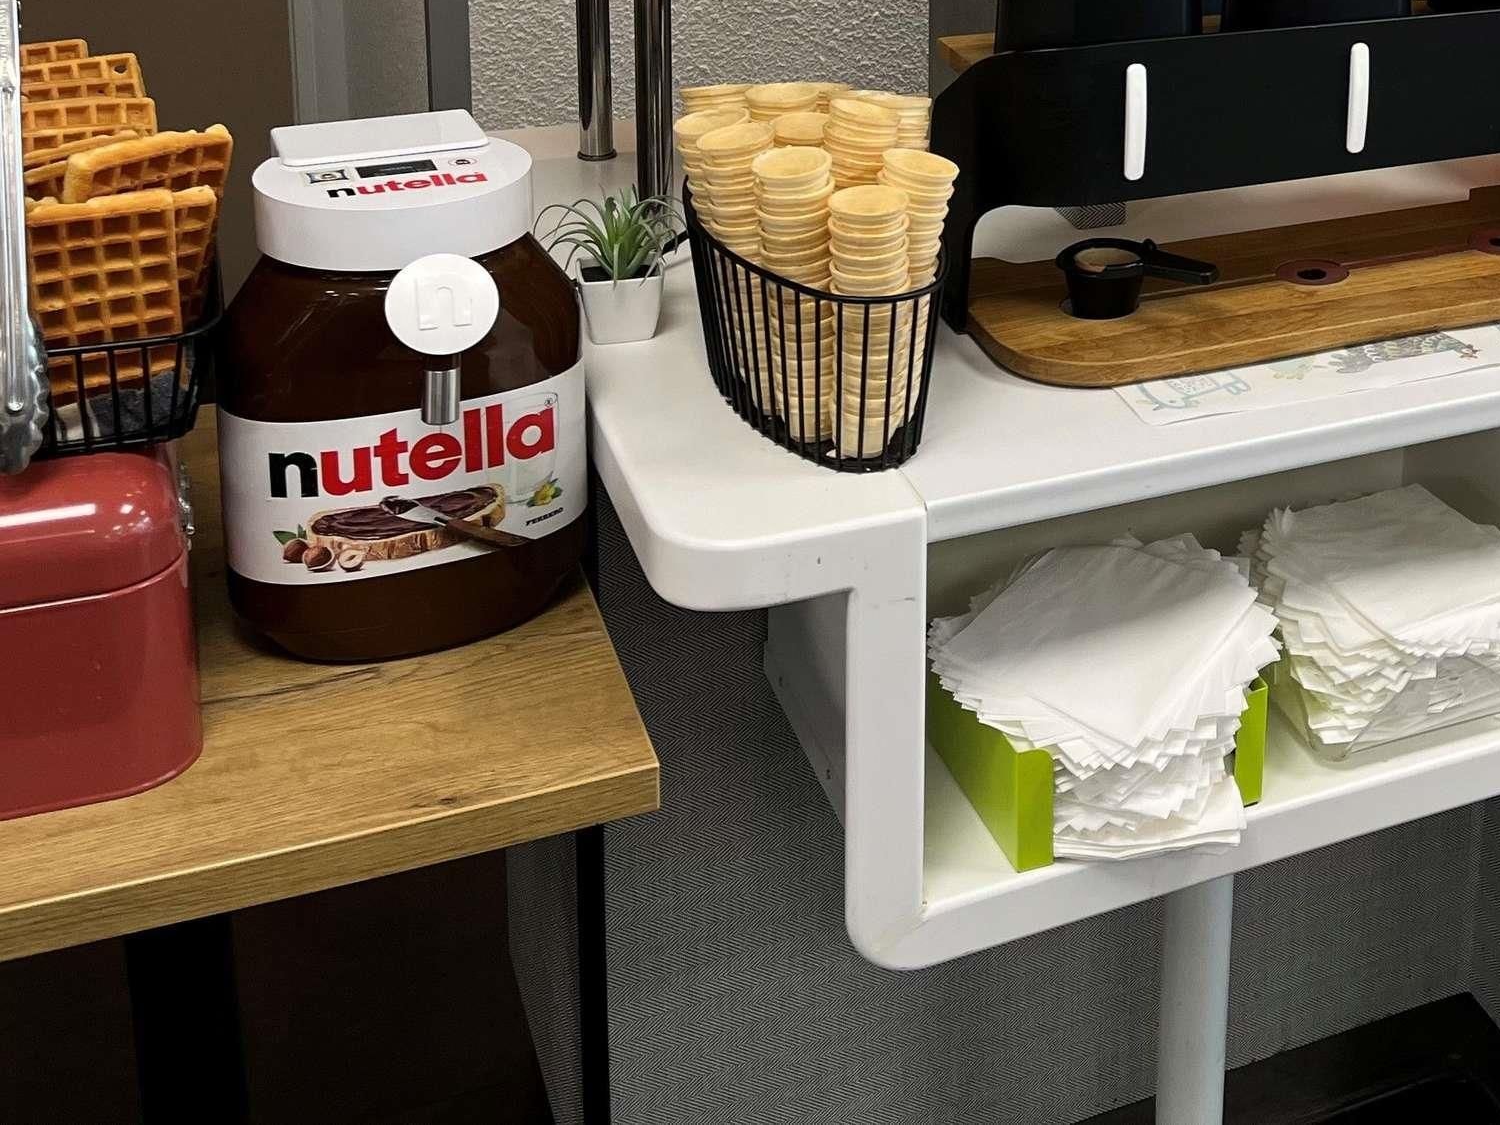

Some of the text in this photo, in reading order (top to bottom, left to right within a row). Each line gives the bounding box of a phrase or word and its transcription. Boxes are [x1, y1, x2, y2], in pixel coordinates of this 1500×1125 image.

[326, 172, 489, 199] nutella
[267, 402, 556, 500] nutella
[525, 506, 564, 527] FERRERO
